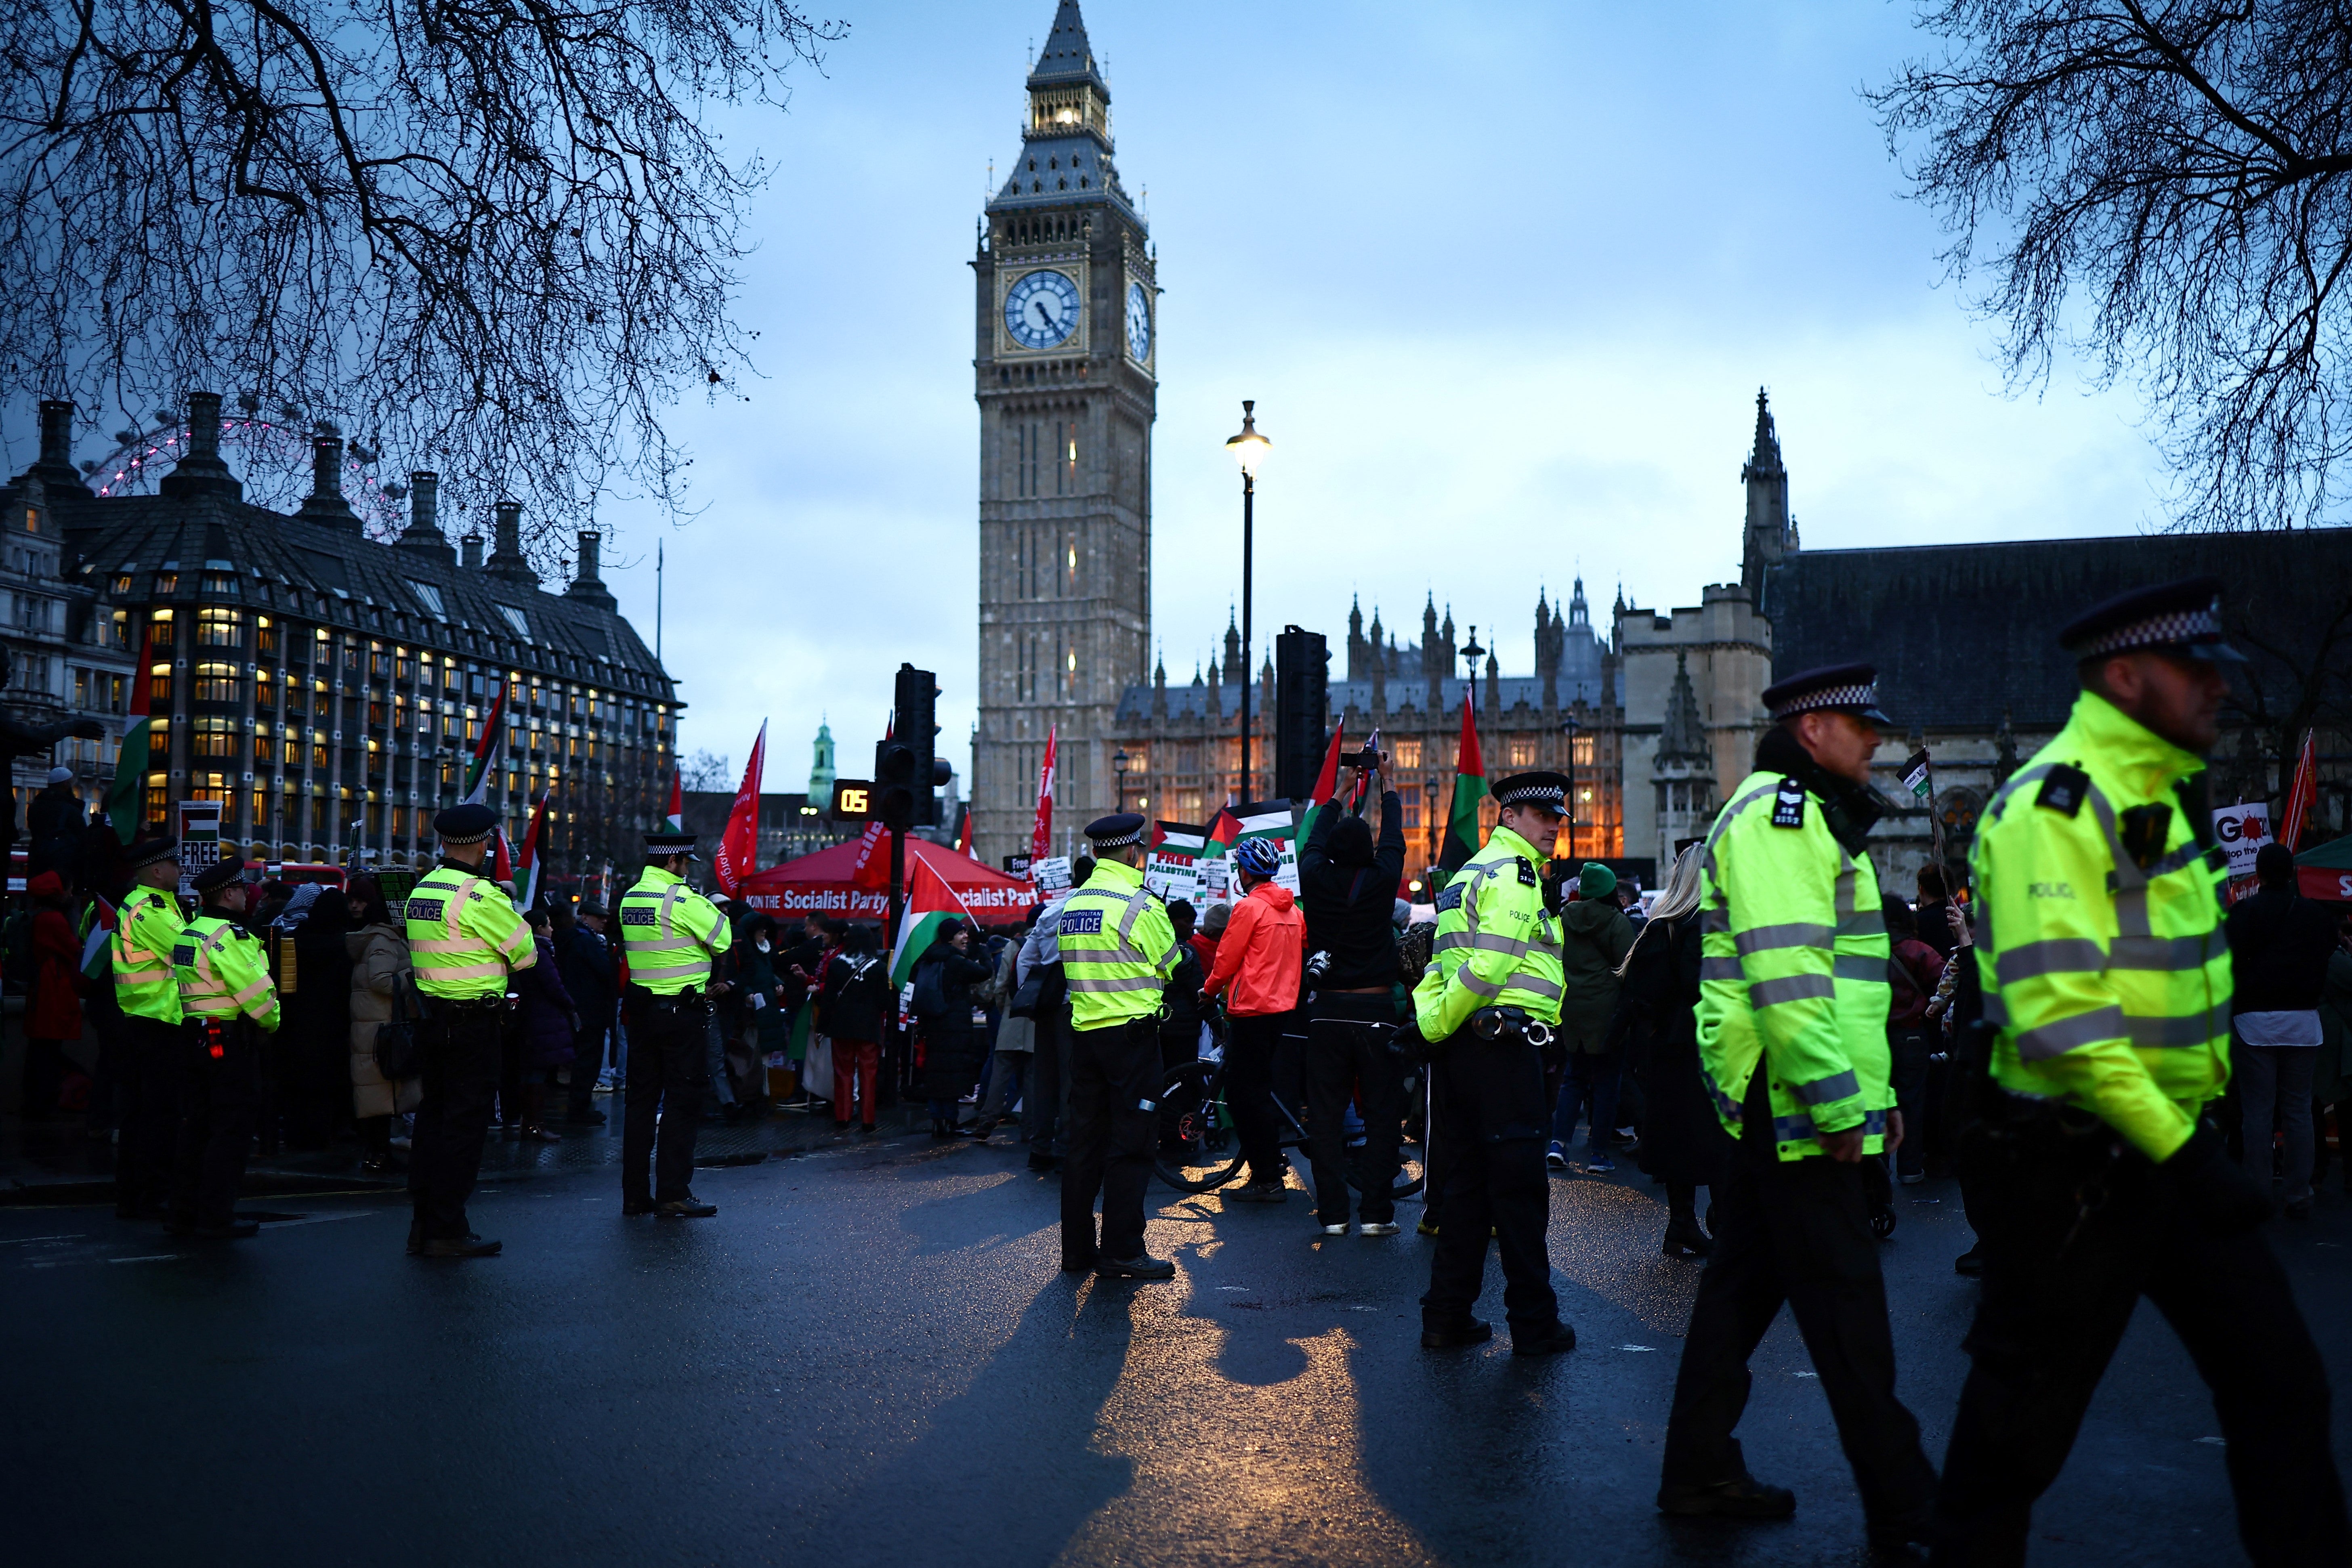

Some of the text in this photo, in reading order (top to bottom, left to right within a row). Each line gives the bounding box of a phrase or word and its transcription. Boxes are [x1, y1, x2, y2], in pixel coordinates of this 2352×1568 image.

[840, 789, 868, 812] 05
[182, 842, 218, 865] FREE
[1156, 850, 1195, 867] FREE
[2224, 847, 2258, 859] top the
[1012, 858, 1029, 869] Free
[1149, 864, 1197, 877] PALESTINE
[746, 890, 889, 915] JOIN THE Socialist Party
[955, 888, 1006, 907] cialist
[1007, 887, 1040, 907] Part
[407, 906, 441, 920] POLICE
[622, 914, 654, 924] POLICE
[1509, 910, 1530, 923] POLICE
[1060, 918, 1100, 933] POLICE
